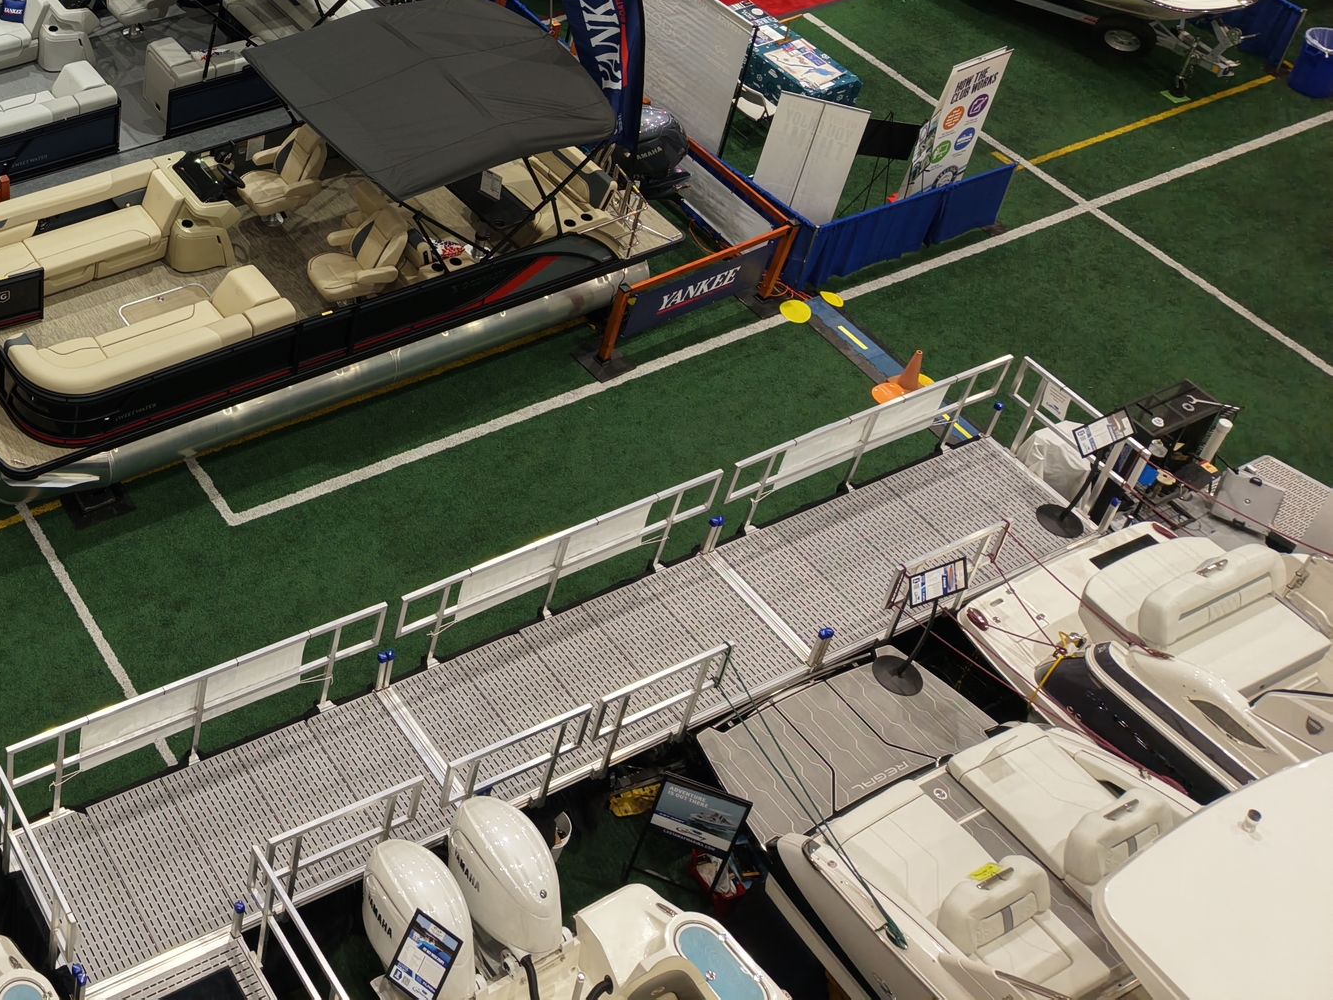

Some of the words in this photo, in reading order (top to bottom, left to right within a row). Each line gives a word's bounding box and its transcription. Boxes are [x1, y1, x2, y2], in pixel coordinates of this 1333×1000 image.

[950, 86, 970, 104] CLUB
[971, 72, 999, 95] WORKS
[955, 75, 974, 93] HOW
[975, 66, 991, 83] THE
[11, 154, 48, 169] SWEETWATER
[636, 145, 664, 161] AMAHA
[658, 265, 741, 312] YANKEE
[115, 402, 157, 423] SWEETWATER
[851, 761, 909, 790] REGAL
[669, 786, 706, 802] ADVENTURE
[675, 793, 688, 801] OUT
[688, 798, 709, 809] THERE
[454, 848, 481, 893] YAMAHA
[368, 896, 393, 939] YAMAHA
